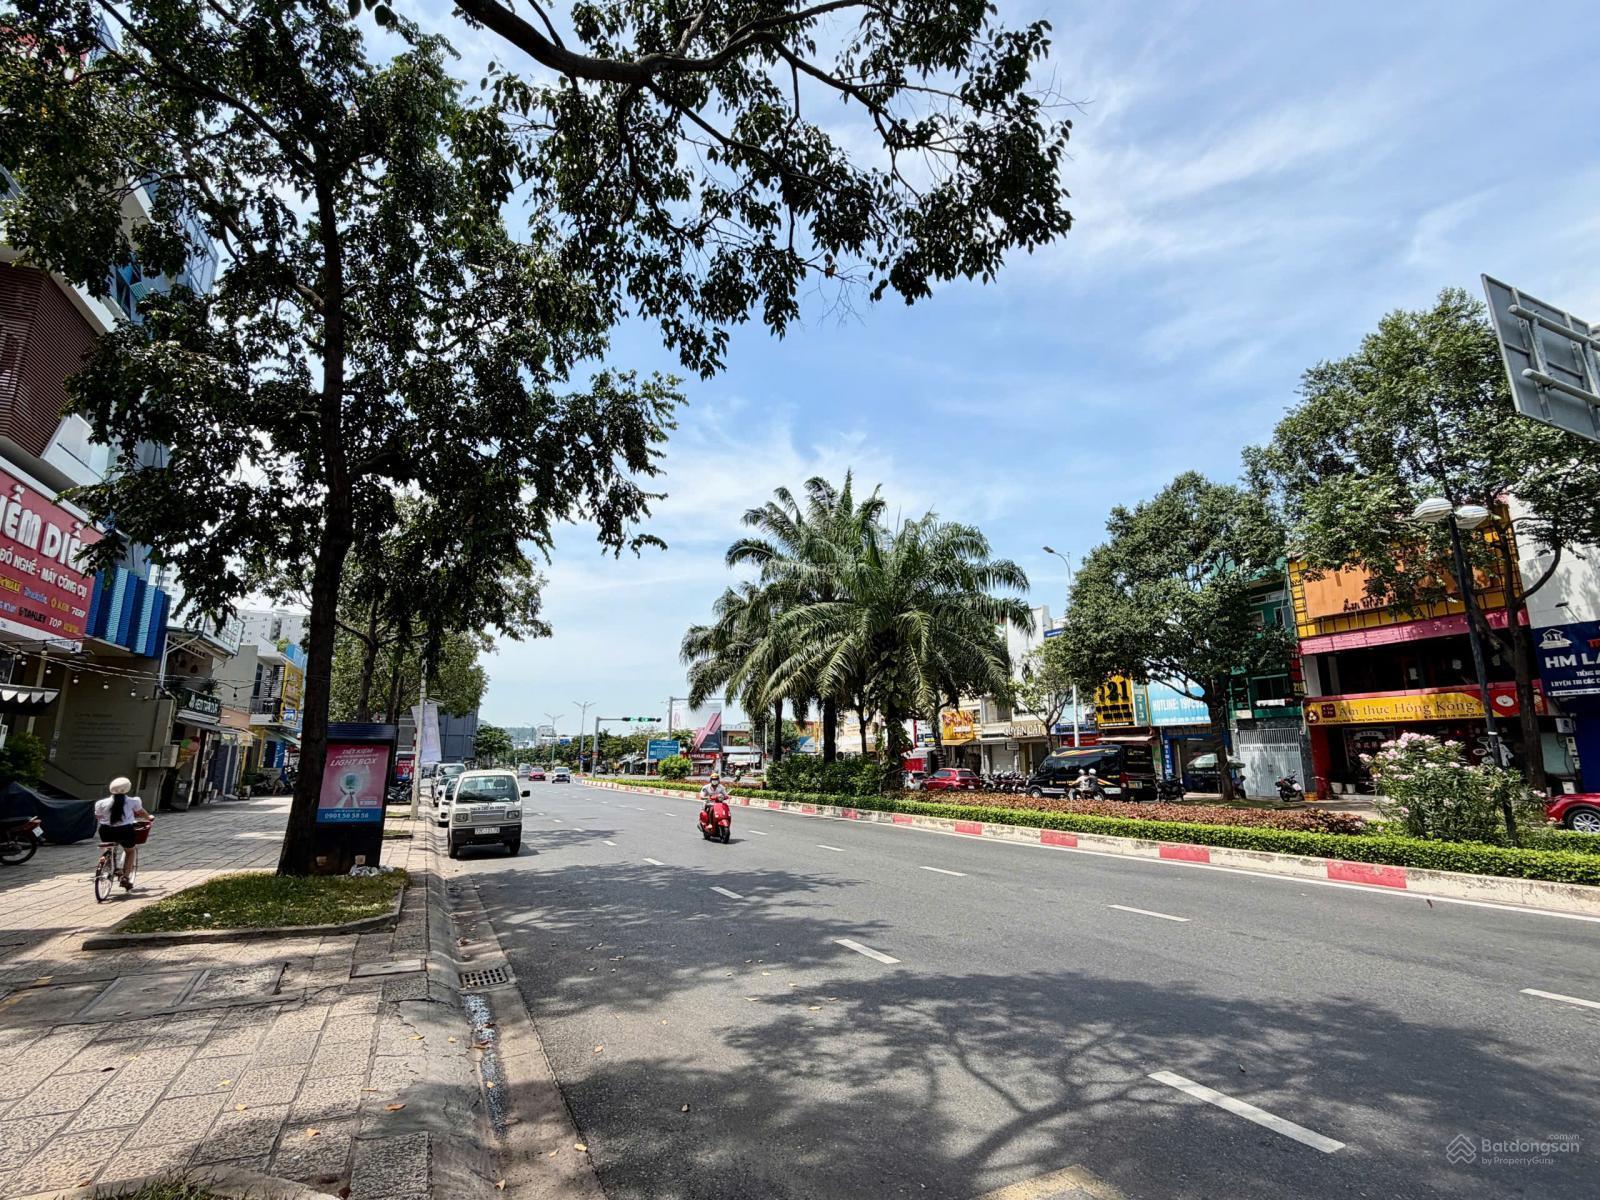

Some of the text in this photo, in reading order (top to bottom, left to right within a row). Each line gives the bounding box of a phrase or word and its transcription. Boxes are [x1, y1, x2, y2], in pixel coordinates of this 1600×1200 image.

[41, 567, 58, 584] MÁY
[57, 574, 77, 594] CÔNG
[49, 617, 62, 629] TOP
[1544, 654, 1577, 669] HM
[330, 759, 358, 767] LIGHT
